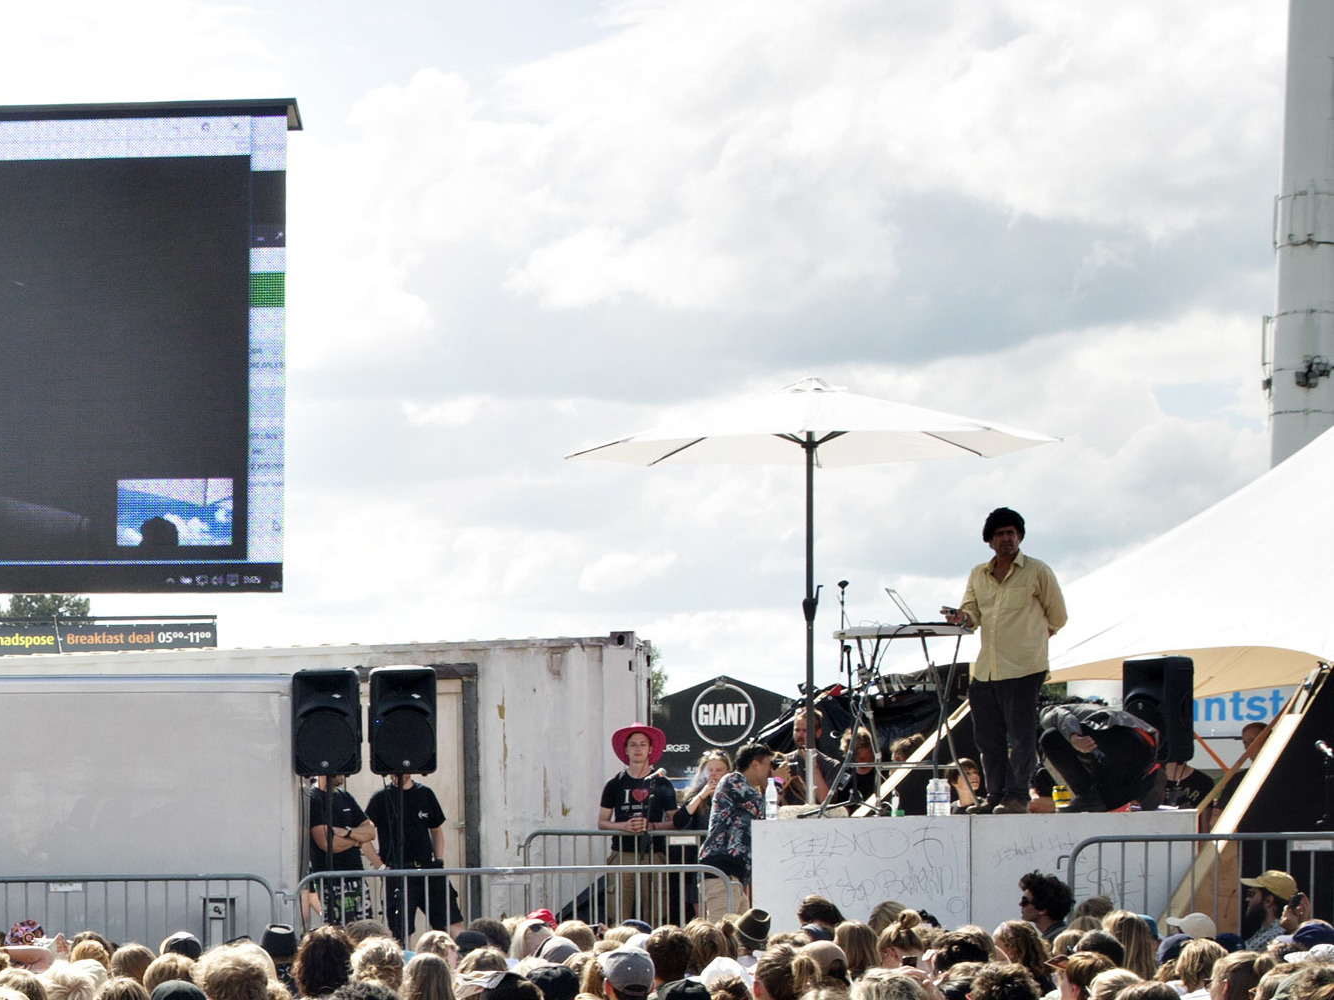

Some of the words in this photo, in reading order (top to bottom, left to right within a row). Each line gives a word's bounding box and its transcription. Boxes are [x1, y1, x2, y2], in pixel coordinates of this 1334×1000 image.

[66, 631, 125, 645] Breakfast
[128, 631, 154, 644] deal
[698, 703, 748, 726] GIANT
[662, 744, 690, 753] URGER
